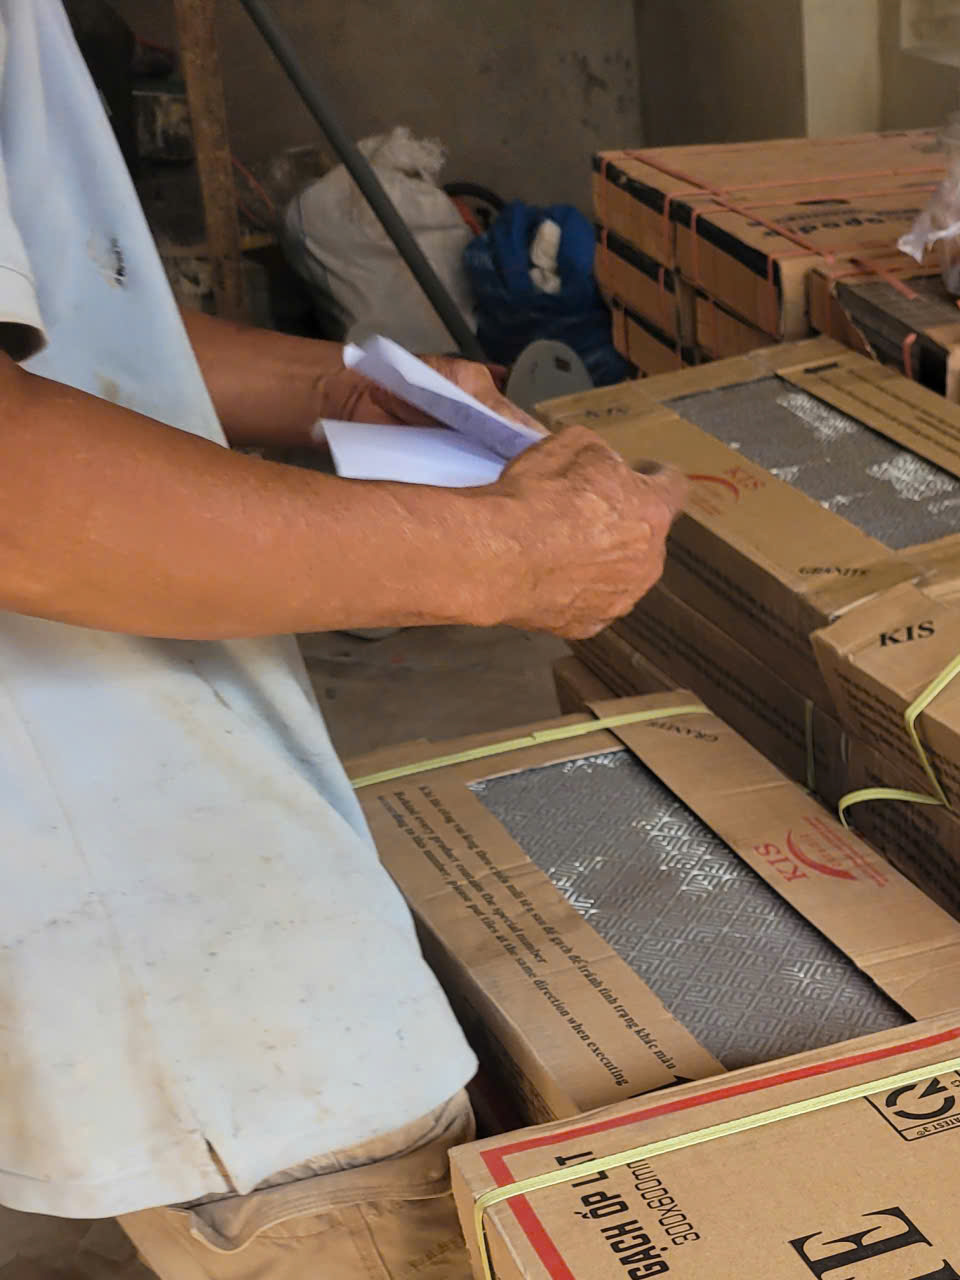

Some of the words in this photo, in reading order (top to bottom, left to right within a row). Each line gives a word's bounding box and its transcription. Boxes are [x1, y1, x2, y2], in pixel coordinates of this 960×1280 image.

[879, 619, 935, 647] KIS
[753, 842, 809, 882] KIS
[531, 977, 573, 1018] direction
[565, 1016, 593, 1042] when
[582, 1039, 631, 1088] executing
[609, 1002, 642, 1030] trạng
[633, 1026, 661, 1051] khác
[652, 1047, 680, 1071] màu
[553, 1146, 609, 1188] LT
[566, 1186, 630, 1224] ỐP
[599, 1215, 676, 1276] GẠCH
